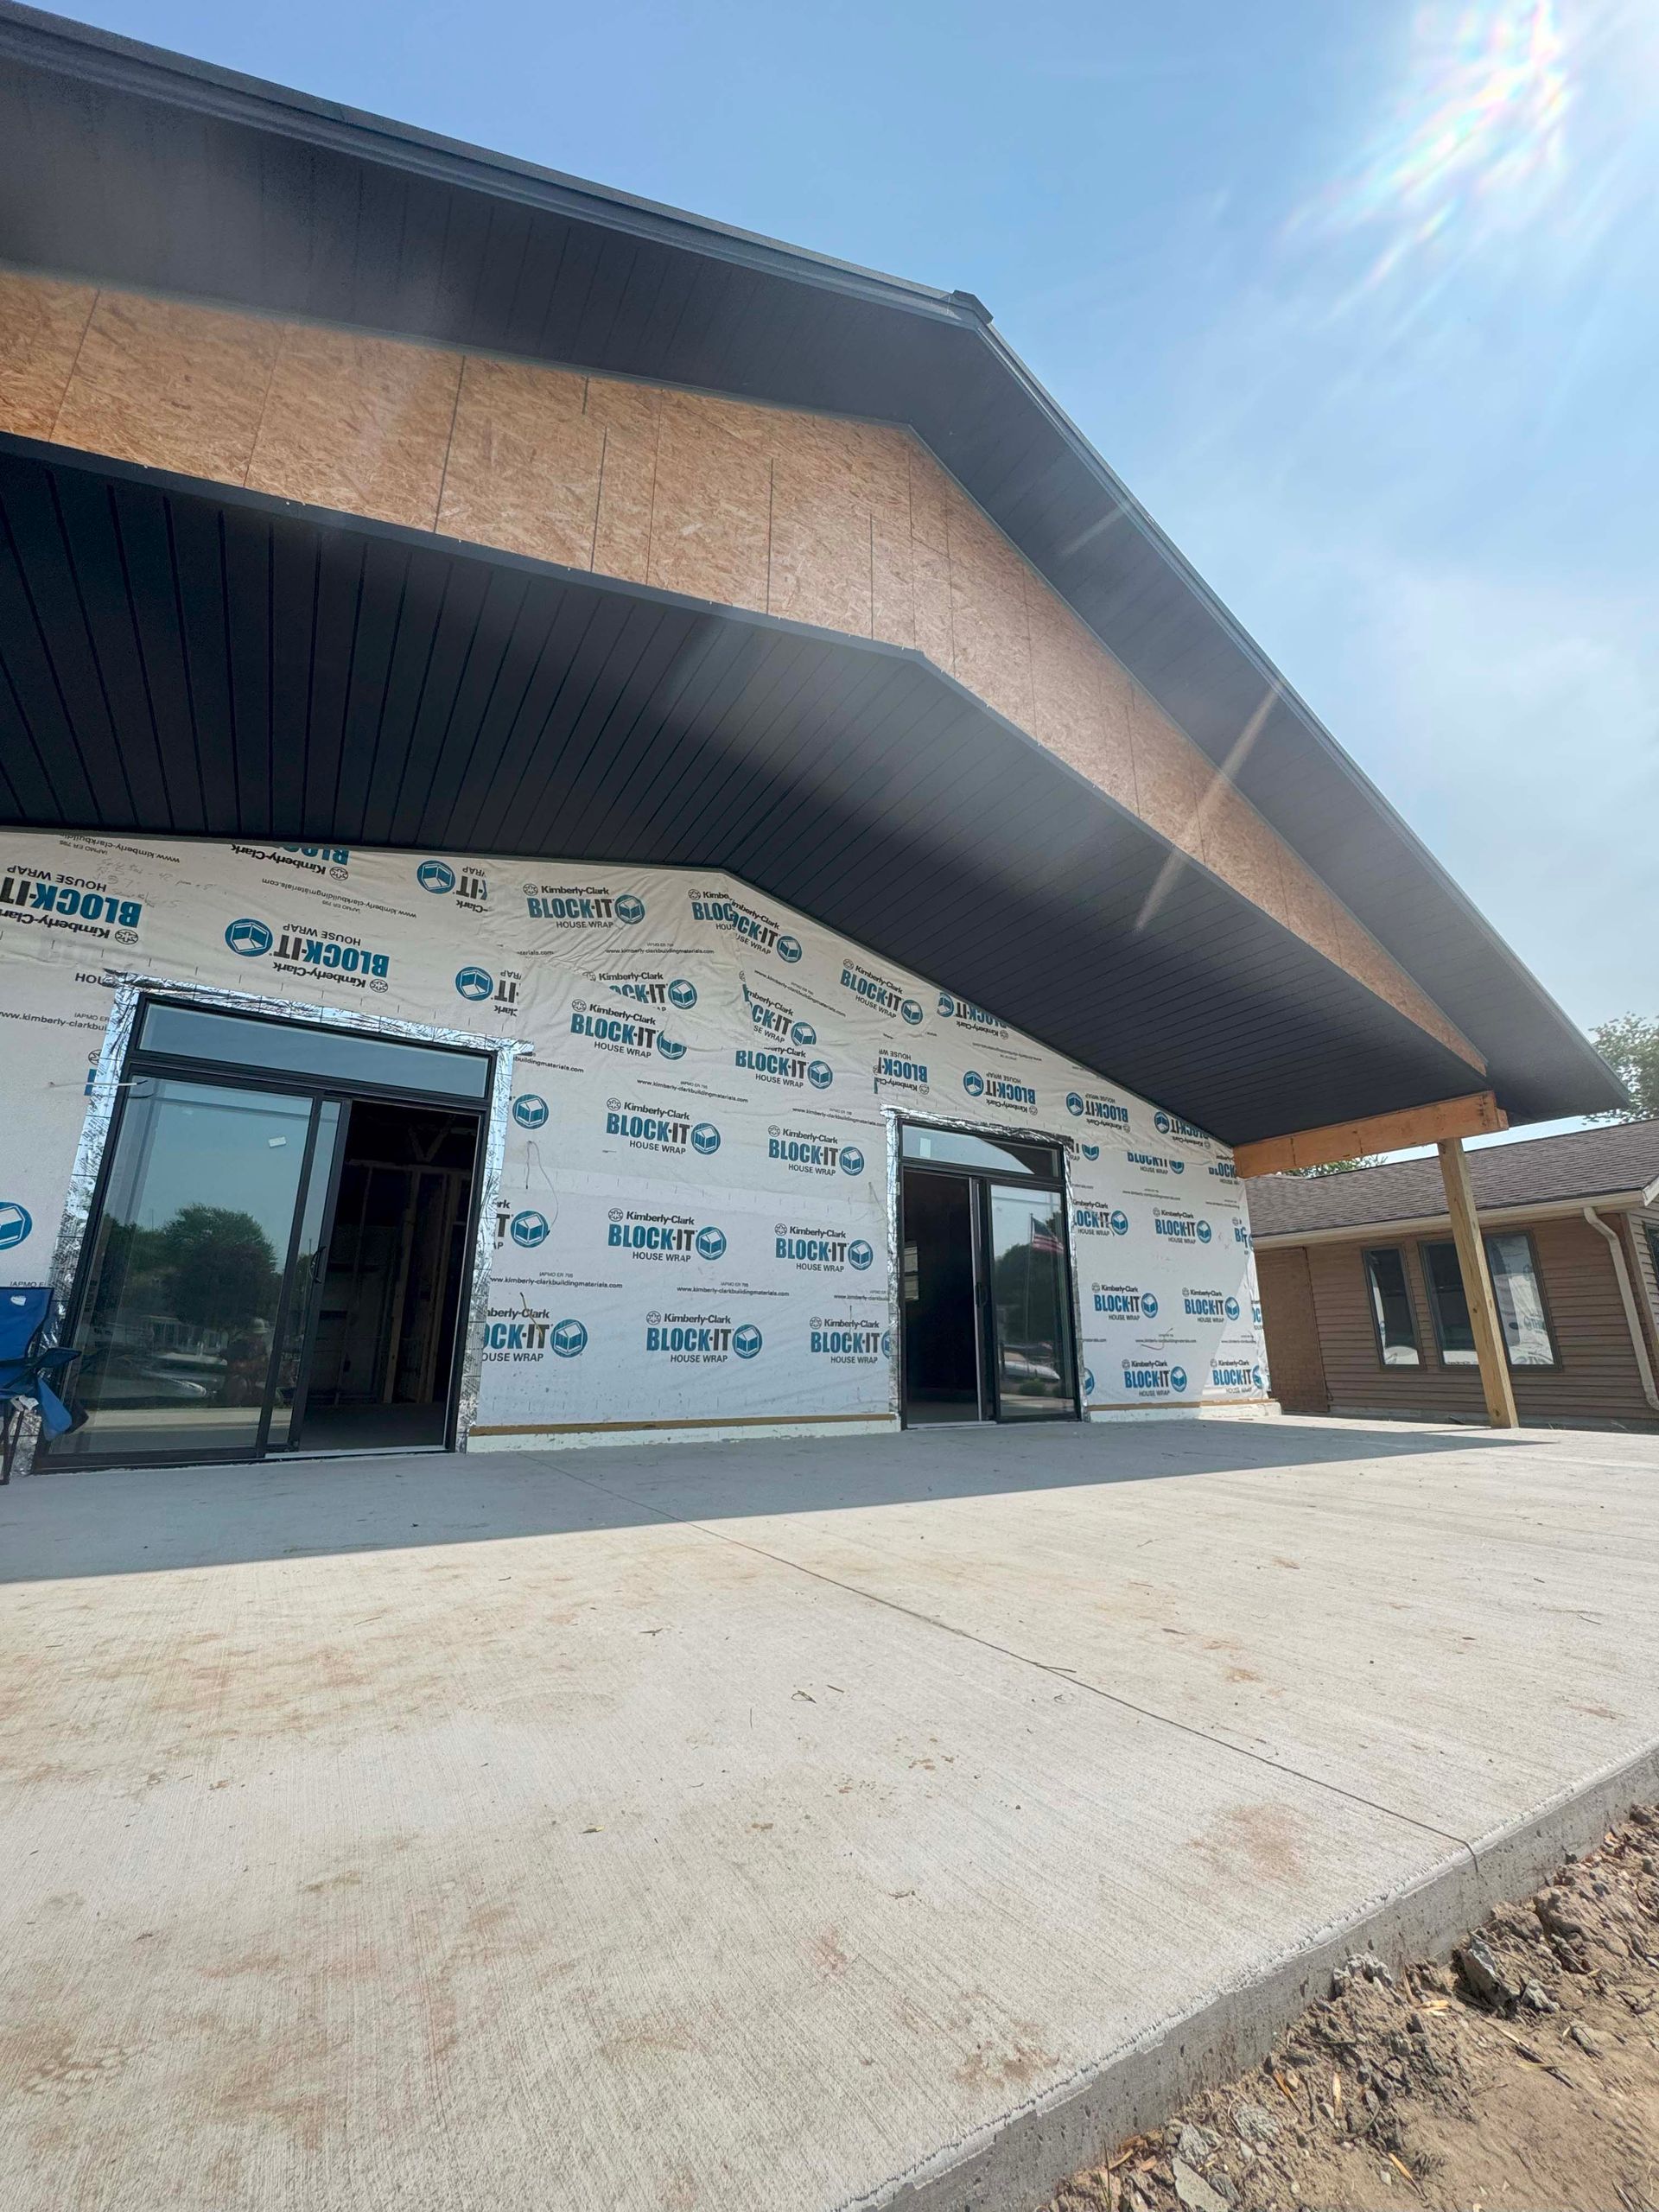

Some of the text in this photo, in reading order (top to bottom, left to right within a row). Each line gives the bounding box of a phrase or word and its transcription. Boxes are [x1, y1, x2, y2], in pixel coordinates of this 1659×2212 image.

[231, 844, 326, 874] Kimberly-Clark
[7, 865, 51, 880] WRAP
[463, 867, 486, 877] RAP
[56, 874, 106, 892] HOUSE
[542, 886, 609, 896] Kimberly-Clark
[283, 923, 361, 946] HOUSE WRAP
[751, 942, 771, 955] WRAP
[272, 962, 365, 988] Kimberly-Clark
[599, 972, 664, 982] Kimberly-Clark
[855, 965, 903, 994] Kimberly-Clark
[855, 995, 897, 1018] HOUSE WRAP
[589, 1004, 656, 1025] Kimberly-Clark
[764, 1031, 785, 1043] WRAP
[594, 1041, 651, 1058] HOUSE WRAP
[890, 1051, 911, 1060] HOUSE
[755, 1074, 804, 1089] HOUSE WRAP
[624, 1102, 690, 1120] Kimberly-Clark
[986, 1099, 1027, 1113] Kimberly-Clark
[783, 1128, 838, 1144] Kimberly-Clark
[629, 1141, 686, 1154] HOUSE WRAP
[789, 1164, 813, 1173] HOUSE
[626, 1211, 694, 1225] Kimberly-Clark
[1161, 1210, 1194, 1218] Kimberly-Clark
[790, 1226, 846, 1238] Kimberly-Clark
[632, 1252, 691, 1262] HOUSE WRAP
[664, 1313, 731, 1325] Kimberly-Clark
[824, 1319, 880, 1330] Kimberly-Clark
[513, 1353, 543, 1362] WRAP
[1131, 1360, 1167, 1369] Kimberly-Clark
